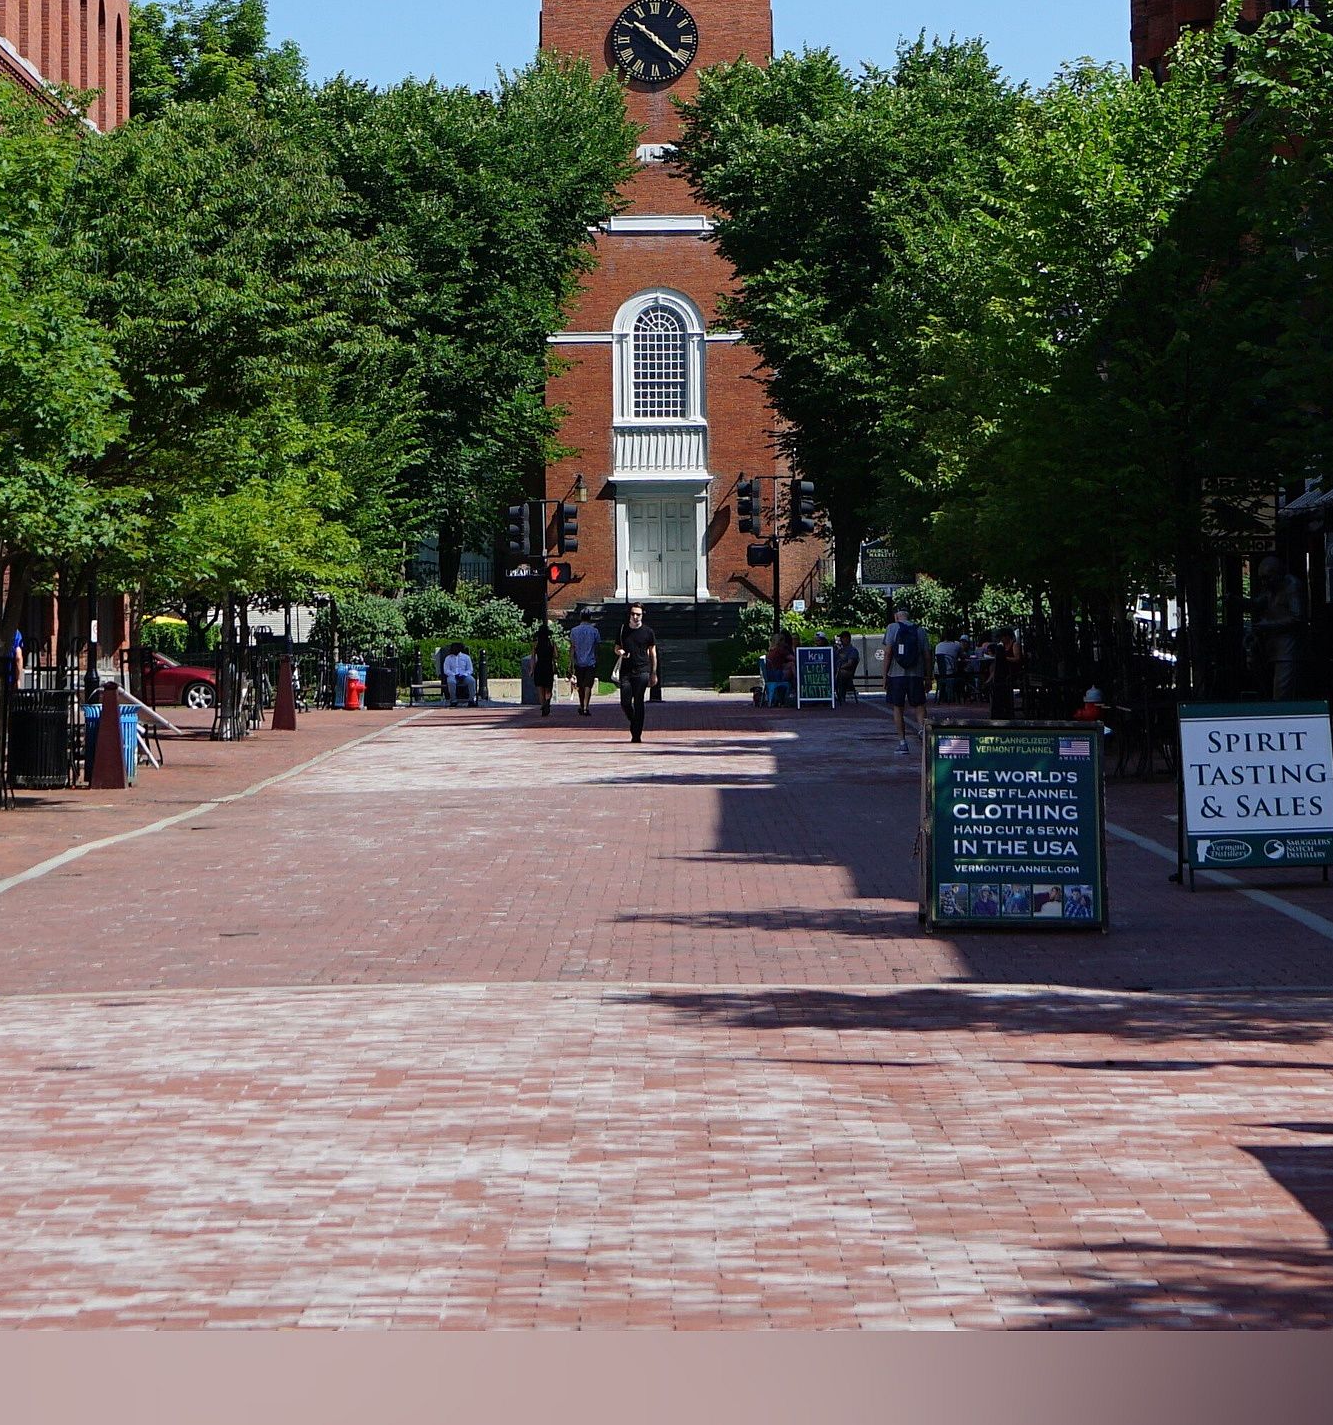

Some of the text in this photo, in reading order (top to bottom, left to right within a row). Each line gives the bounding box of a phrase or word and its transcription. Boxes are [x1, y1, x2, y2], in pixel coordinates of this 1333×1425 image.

[650, 2, 660, 15] XII
[666, 7, 675, 18] I
[676, 18, 689, 29] II
[618, 36, 630, 44] IX
[680, 35, 693, 43] III
[620, 47, 635, 63] VIII
[652, 64, 660, 76] VI
[668, 61, 677, 73] V
[1208, 730, 1307, 754] SPIRIT
[976, 745, 1054, 754] VERMONT FLANNEL
[953, 769, 1078, 784] THE WORLD'S
[1190, 763, 1326, 786] TASTING
[953, 787, 1078, 800] FINEST FLANNEL
[953, 803, 1079, 820] CLOTHING
[1200, 795, 1323, 819] & SALES
[953, 825, 1079, 836] HAND CUT & SEWN
[953, 839, 1079, 855] IN THE USA
[954, 865, 1080, 873] VERMONTFLANNEL.COM
